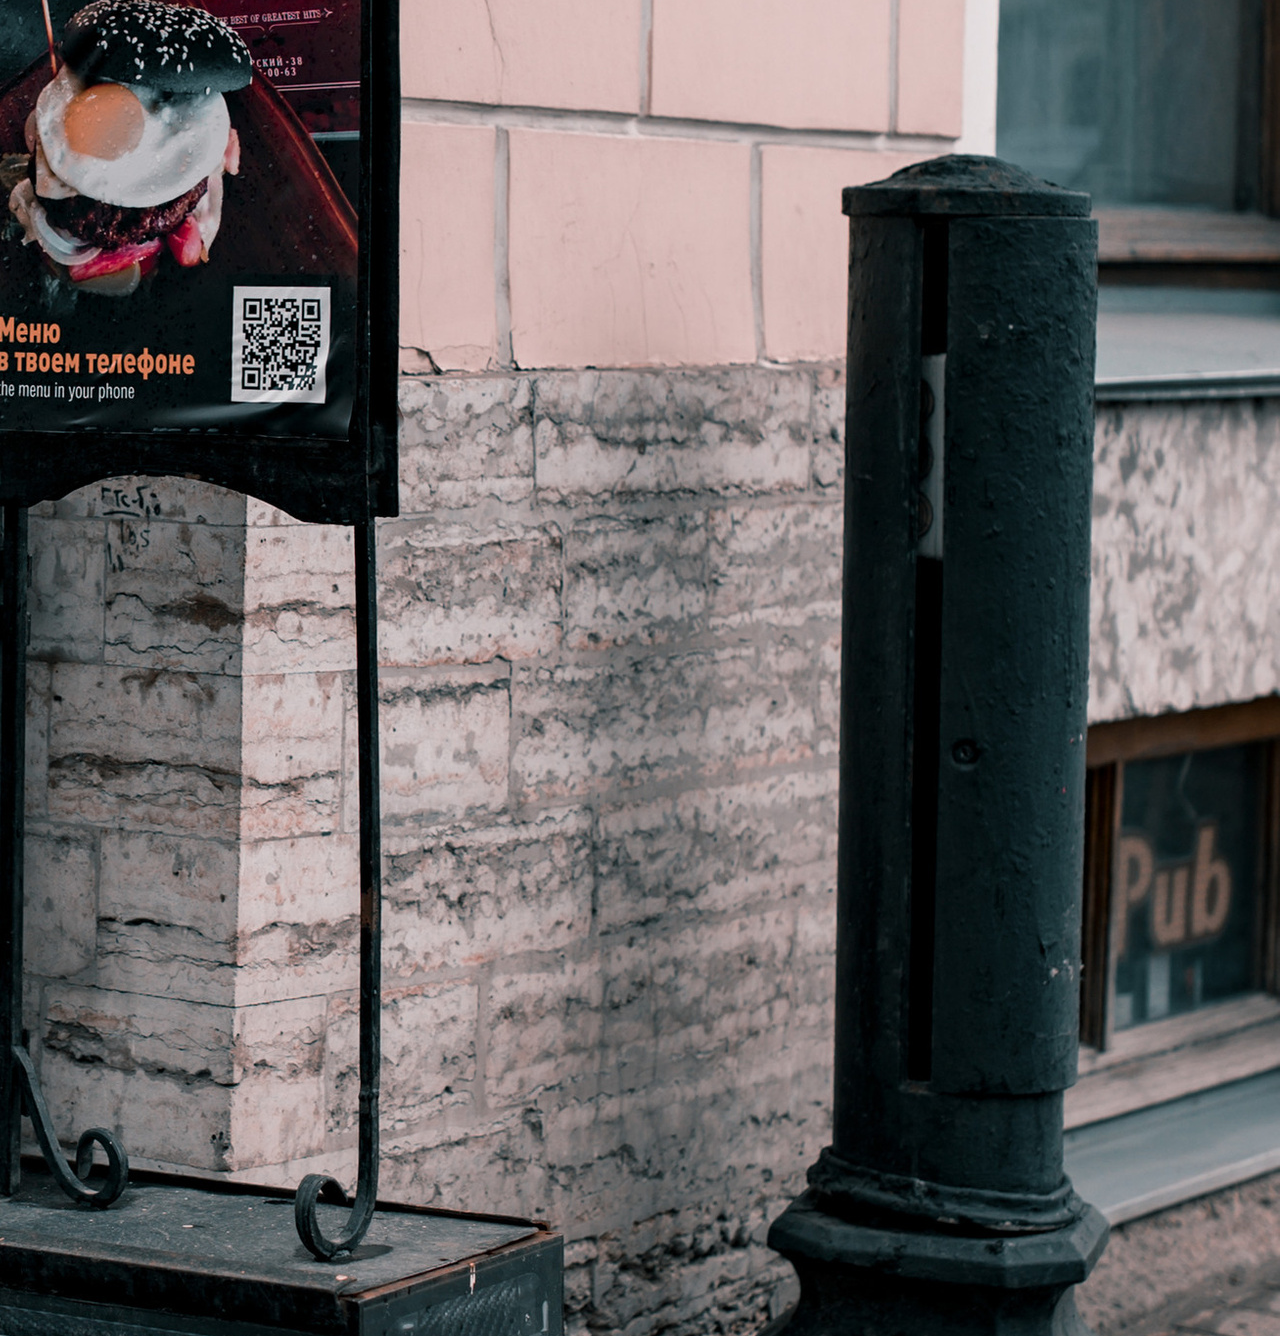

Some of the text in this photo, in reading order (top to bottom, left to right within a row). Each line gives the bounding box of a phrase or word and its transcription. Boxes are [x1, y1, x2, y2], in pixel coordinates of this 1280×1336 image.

[230, 14, 249, 25] BEST
[250, 15, 260, 23] OF
[262, 11, 300, 21] GREATEST
[303, 9, 321, 18] HITS
[14, 351, 80, 374] твоем
[85, 347, 196, 381] телефоне
[18, 383, 51, 398] menu
[54, 382, 65, 399] in
[68, 385, 95, 402] your
[98, 383, 135, 402] phone
[1120, 827, 1231, 956] Pub
